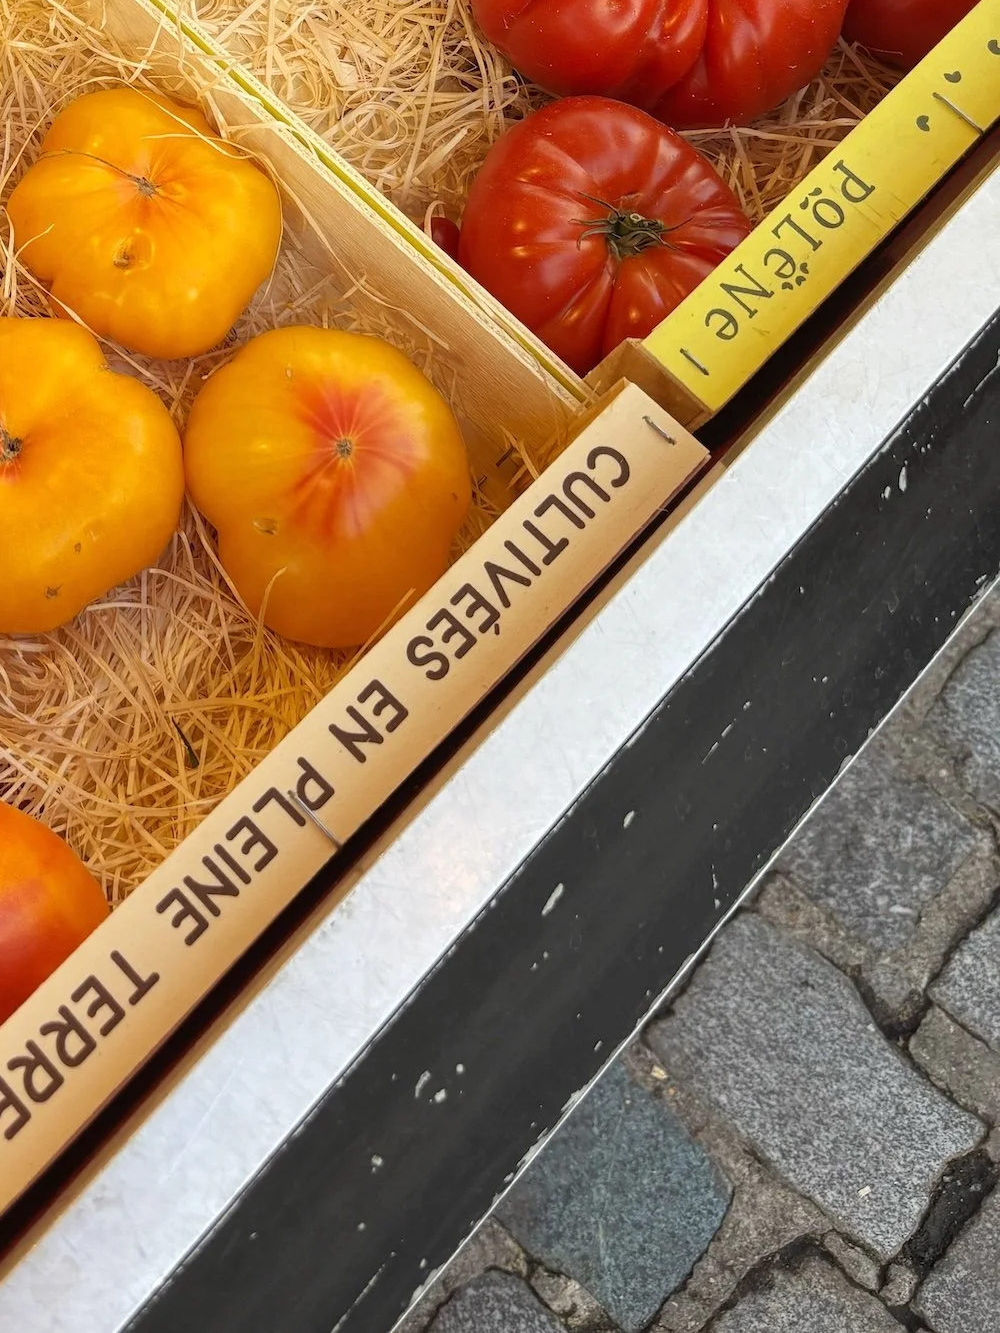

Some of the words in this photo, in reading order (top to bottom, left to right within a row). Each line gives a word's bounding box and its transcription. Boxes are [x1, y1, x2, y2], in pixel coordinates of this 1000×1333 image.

[407, 445, 632, 680] CULTIVÉES
[328, 679, 409, 764] EN
[155, 757, 335, 947] PLEINE
